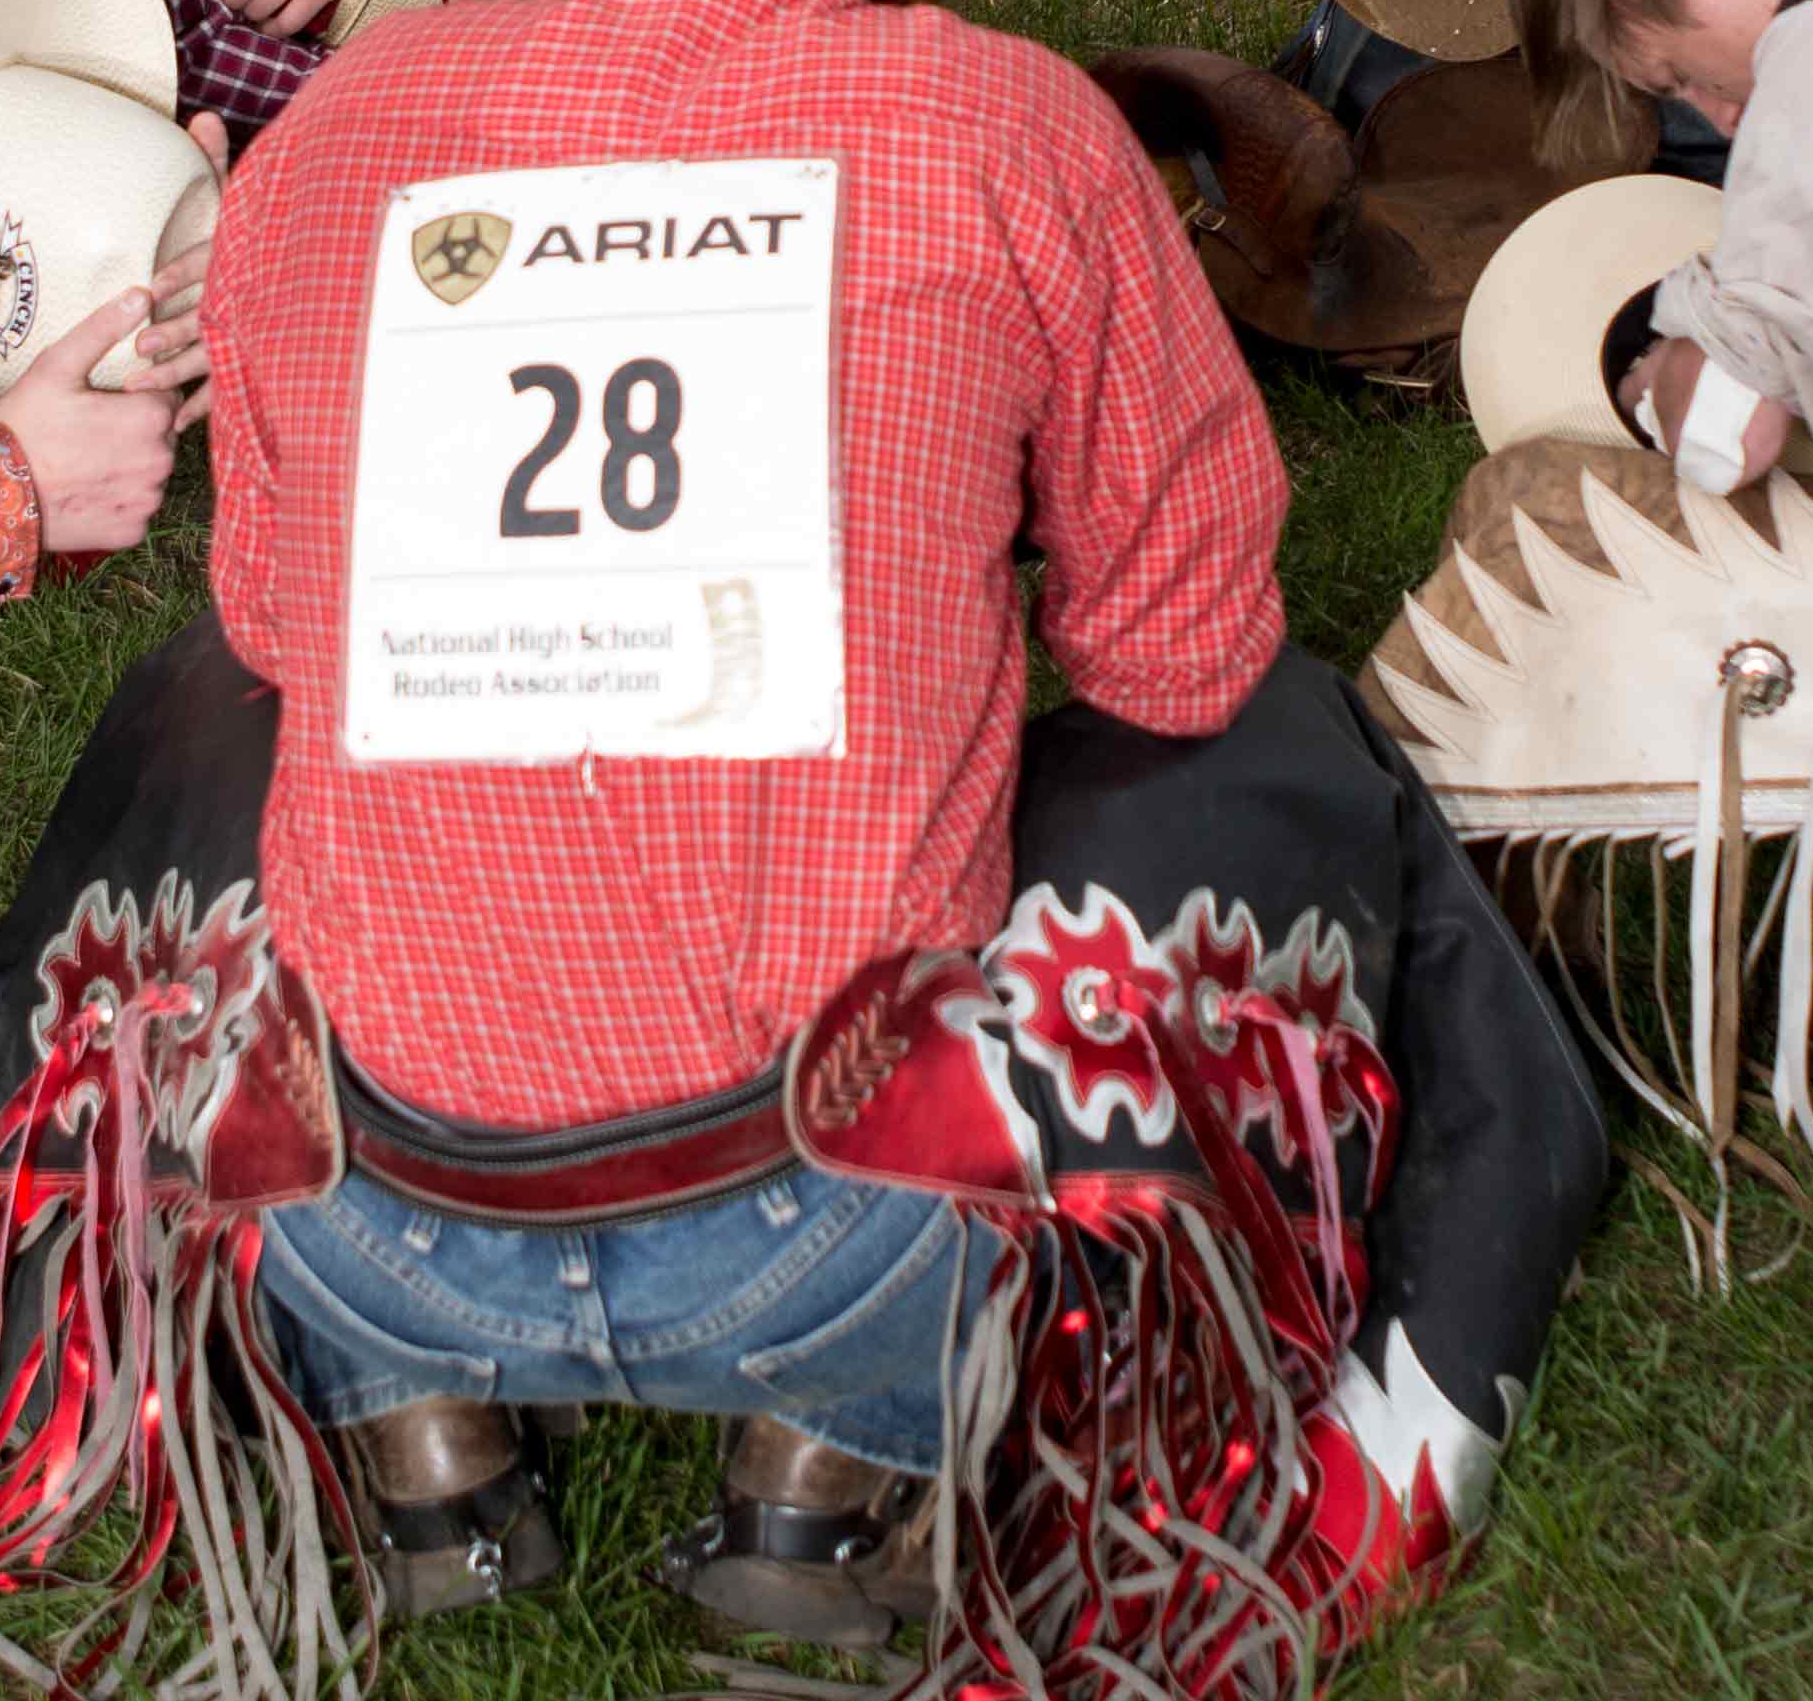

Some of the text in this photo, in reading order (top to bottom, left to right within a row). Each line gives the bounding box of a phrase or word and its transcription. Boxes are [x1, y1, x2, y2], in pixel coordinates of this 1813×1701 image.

[522, 212, 803, 268] ARIAT
[9, 262, 34, 335] CINCH
[499, 356, 684, 539] 28
[579, 620, 674, 651] School
[393, 669, 482, 699] Rodeo
